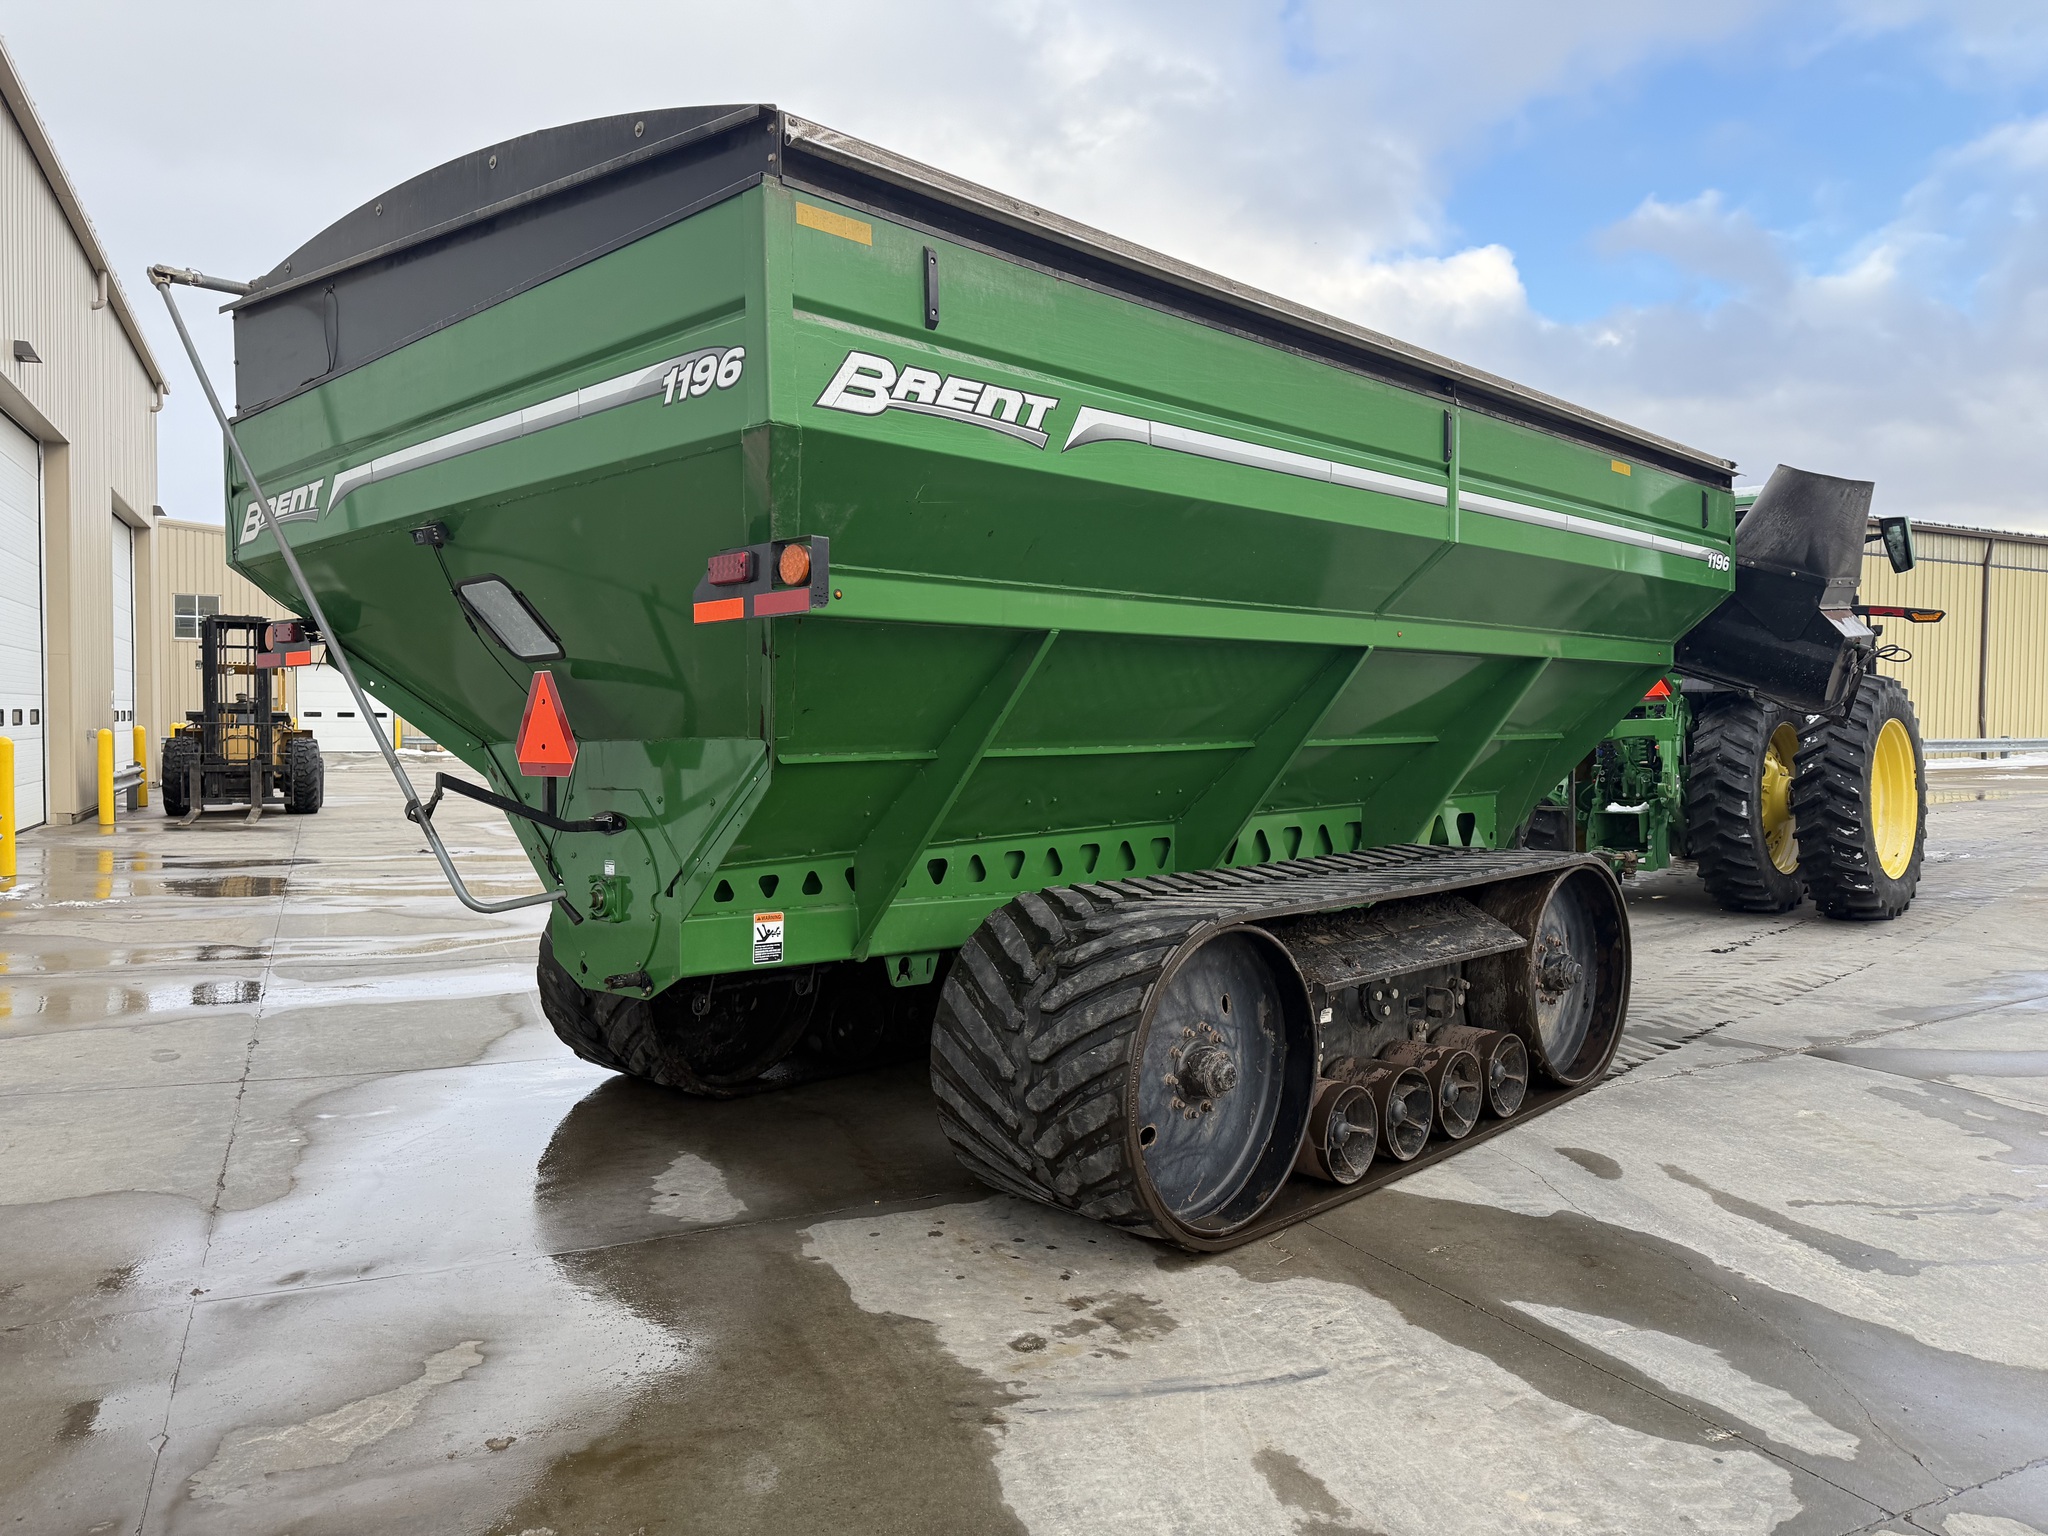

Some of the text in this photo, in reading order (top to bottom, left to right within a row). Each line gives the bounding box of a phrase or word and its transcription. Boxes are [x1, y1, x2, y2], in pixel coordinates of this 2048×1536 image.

[662, 346, 745, 407] 1196
[815, 350, 1060, 431] BRENT
[1708, 552, 1730, 572] 1196
